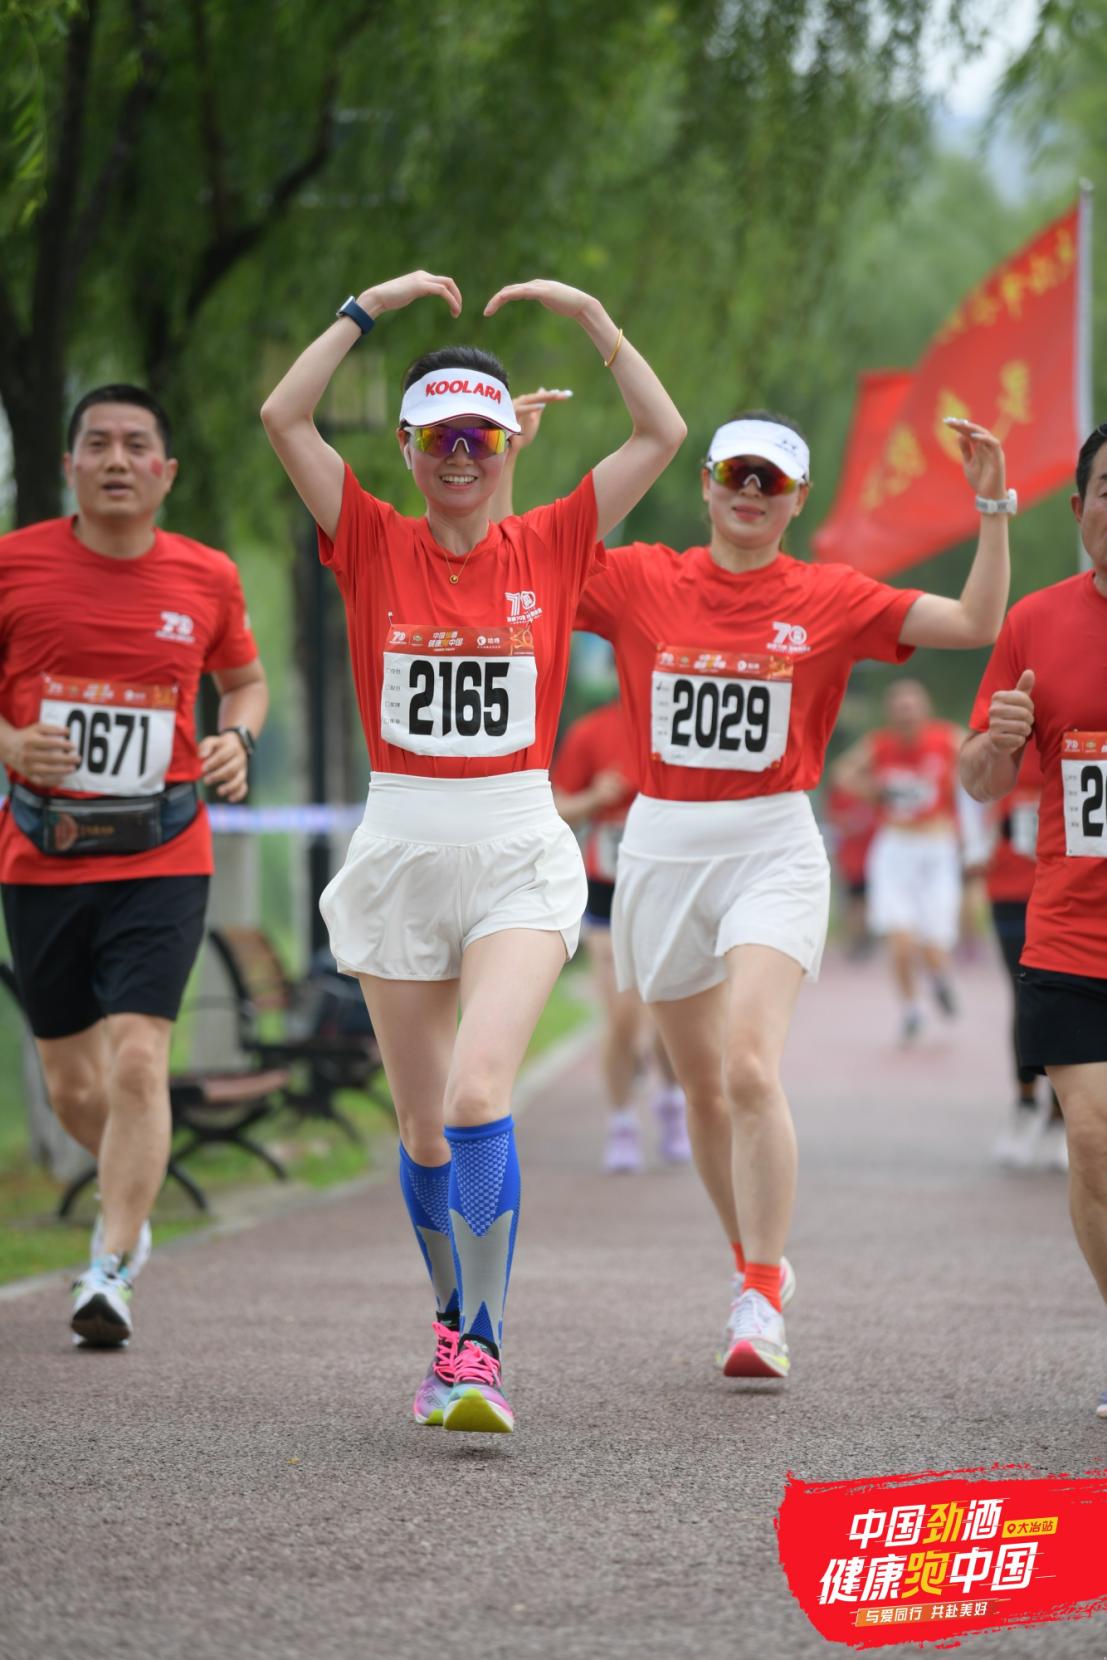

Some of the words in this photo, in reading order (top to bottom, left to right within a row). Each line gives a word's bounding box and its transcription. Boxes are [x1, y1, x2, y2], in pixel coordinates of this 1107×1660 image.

[425, 380, 501, 404] KOOLARA
[408, 659, 510, 737] 2165
[671, 679, 770, 752] 2029
[65, 710, 149, 777] 0671
[1081, 765, 1107, 837] 2
